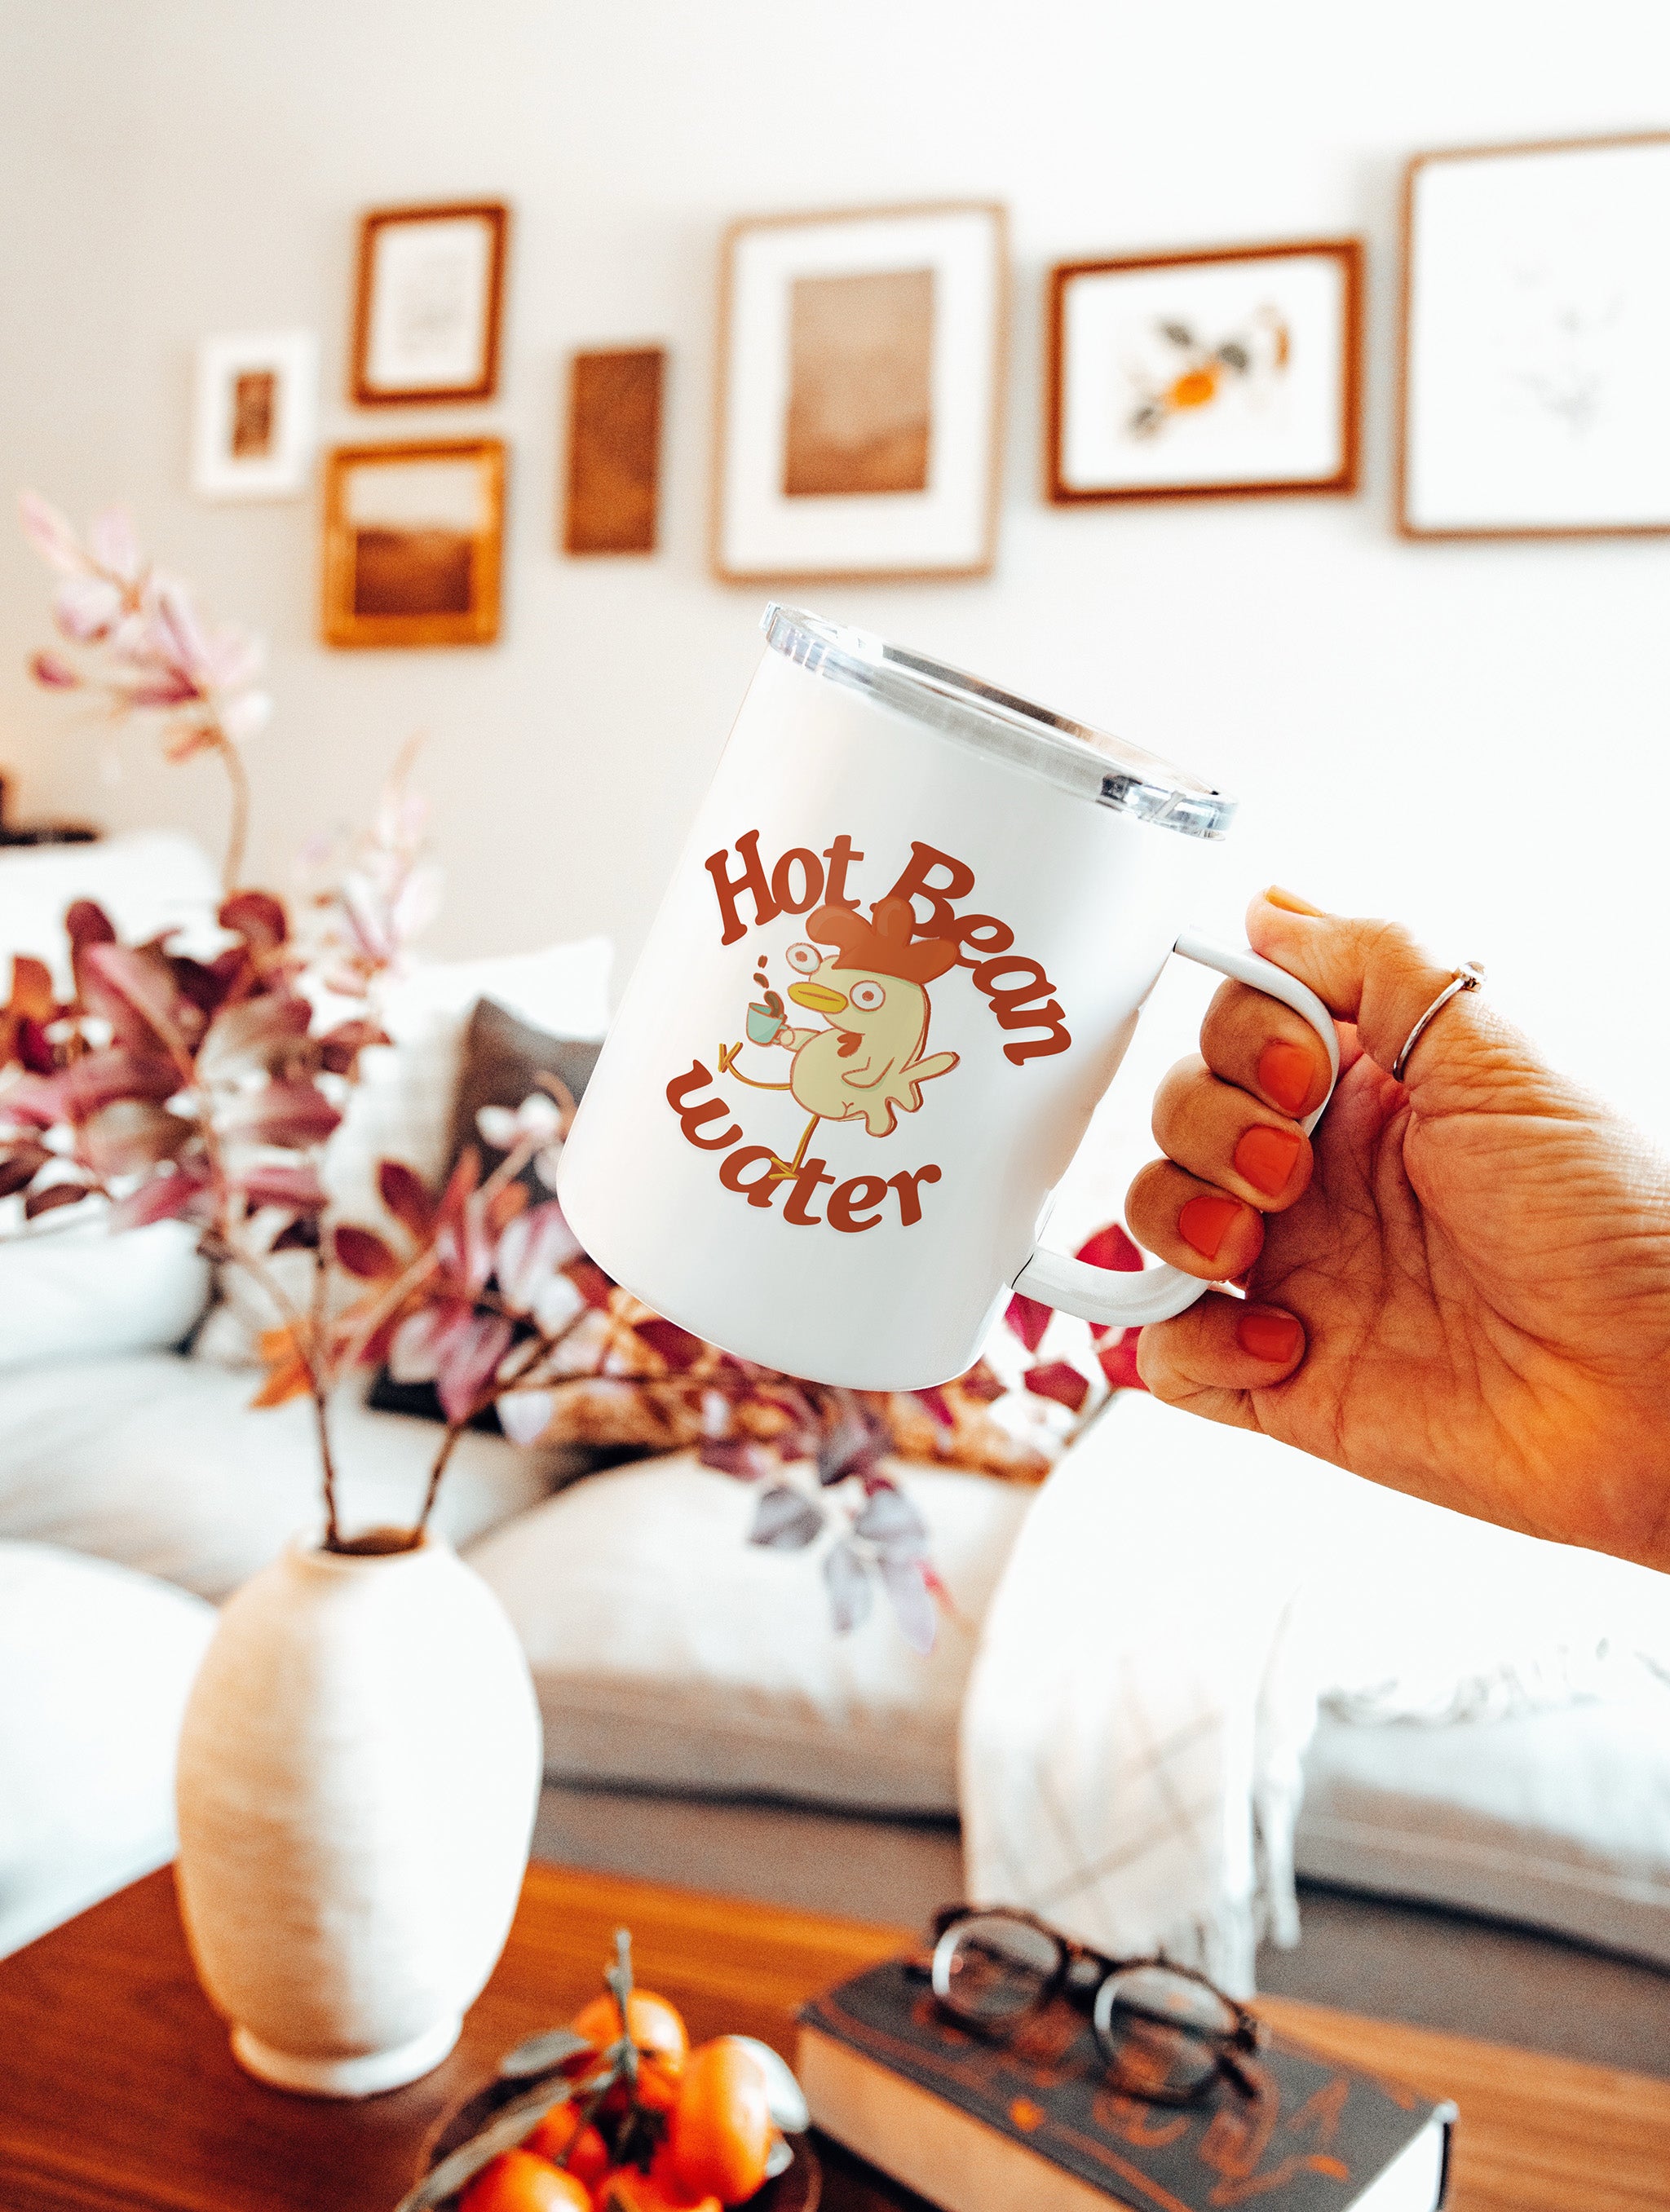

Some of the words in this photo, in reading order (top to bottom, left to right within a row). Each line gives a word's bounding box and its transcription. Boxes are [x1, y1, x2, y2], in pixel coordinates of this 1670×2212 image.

[705, 828, 864, 947] Hot
[868, 841, 1072, 1066] Bean
[665, 1059, 943, 1234] water
